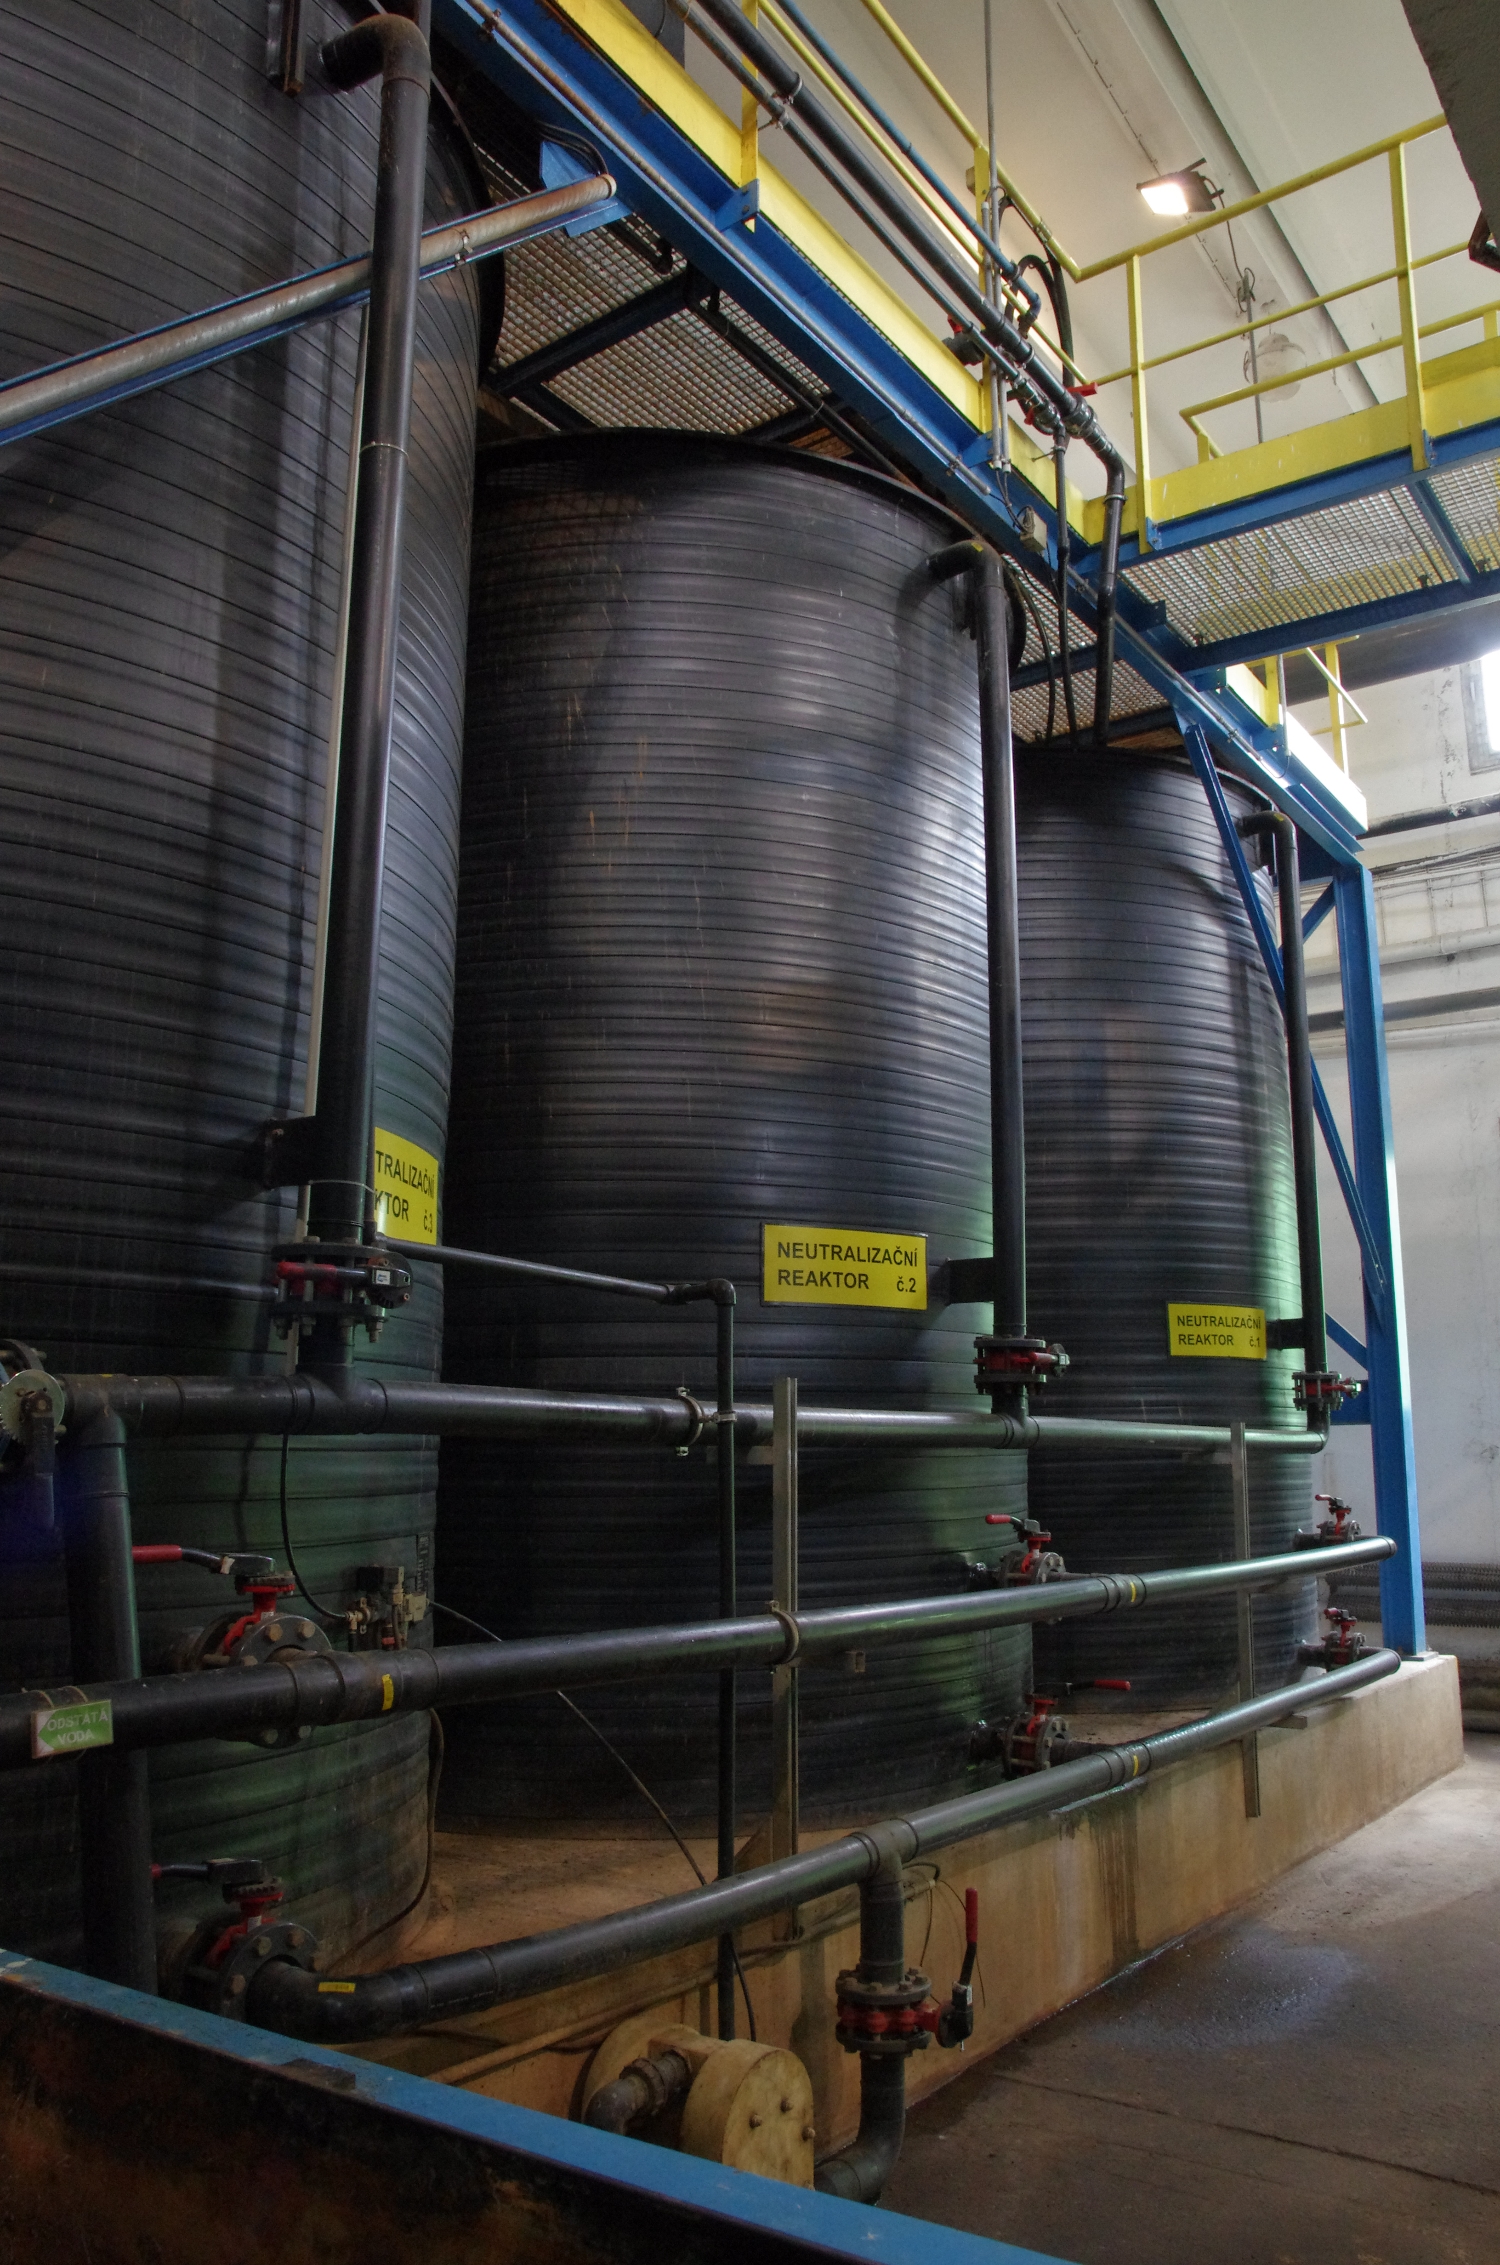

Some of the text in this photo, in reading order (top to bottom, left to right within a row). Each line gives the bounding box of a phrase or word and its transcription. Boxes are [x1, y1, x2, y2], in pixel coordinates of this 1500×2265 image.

[375, 1149, 435, 1200] TRALIZAČNÍ
[375, 1188, 409, 1222] KTOR
[777, 1241, 918, 1267] NEUTRALIZAČNÍ
[777, 1269, 917, 1293] REAKTOR č.2
[1176, 1314, 1262, 1330] NEUTRALIZAČNÍ
[1178, 1333, 1261, 1347] REAKTOR č.1
[57, 1729, 95, 1745] VODA
